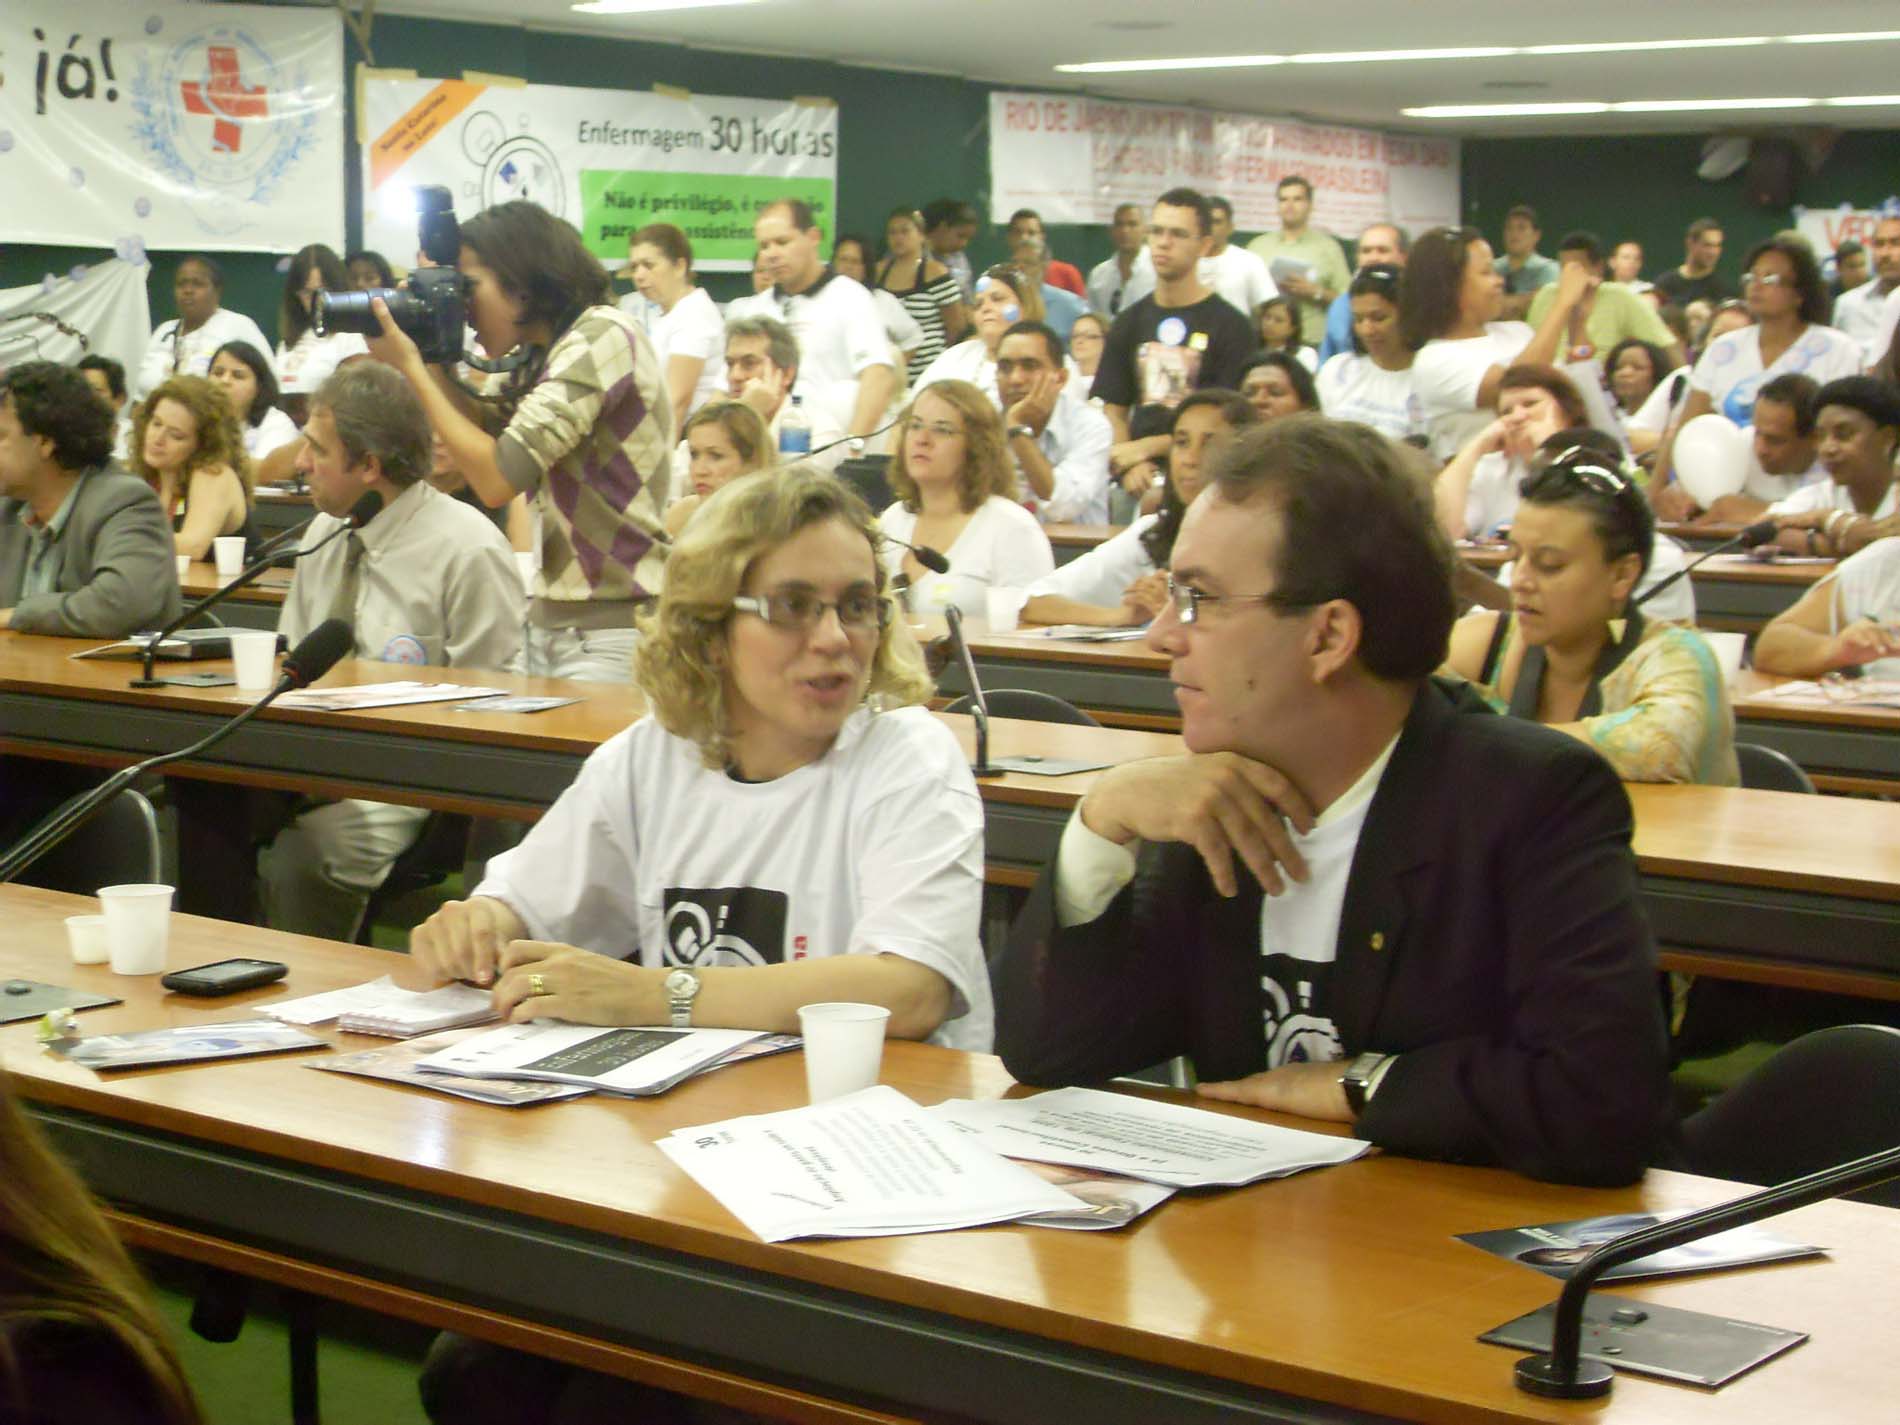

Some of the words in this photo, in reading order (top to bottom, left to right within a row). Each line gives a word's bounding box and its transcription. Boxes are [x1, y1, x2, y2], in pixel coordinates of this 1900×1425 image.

[33, 27, 119, 115] já!
[1005, 101, 1039, 132] RIO
[1044, 101, 1068, 132] DE
[578, 120, 704, 152] Enfermagem
[709, 116, 742, 152] 30
[752, 117, 834, 157] horas
[604, 191, 636, 209] Não
